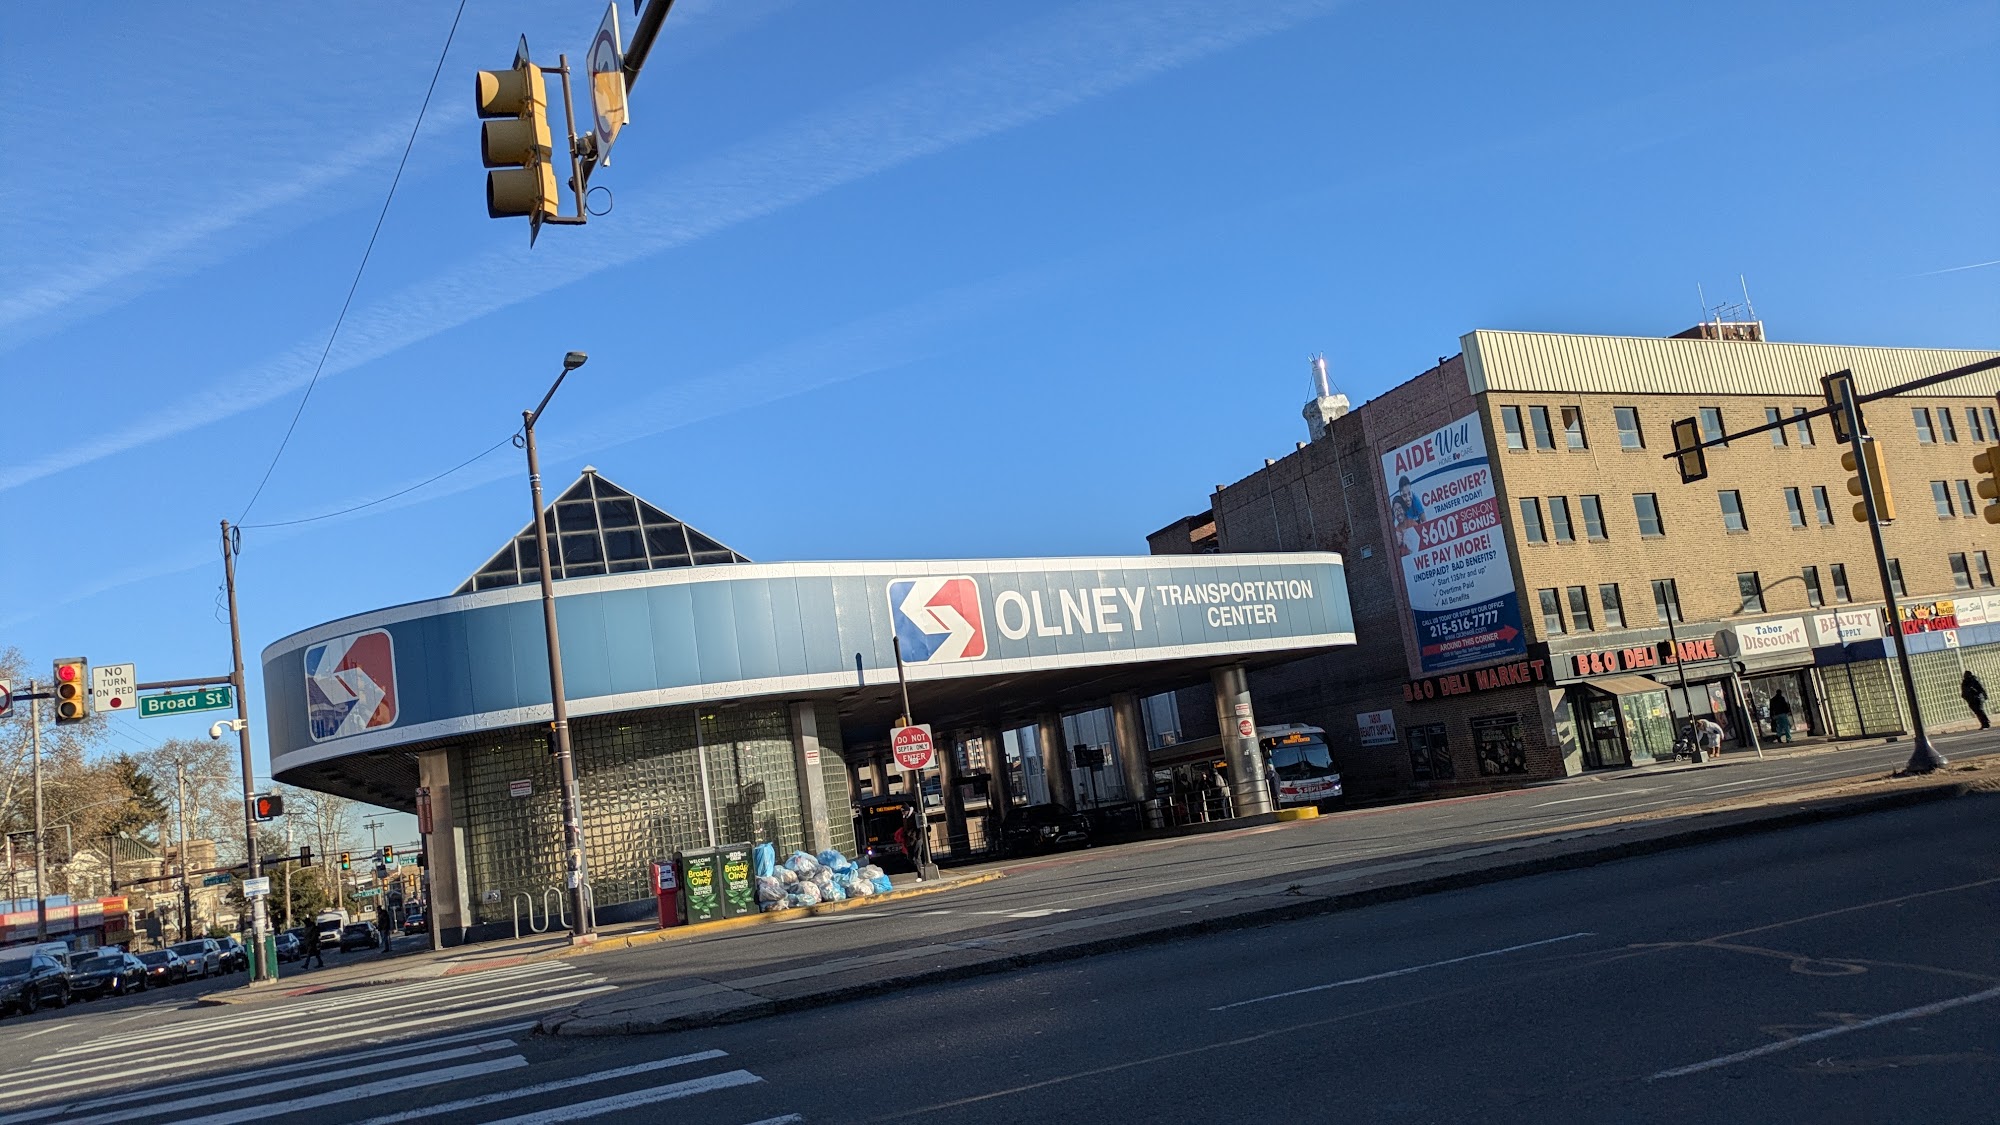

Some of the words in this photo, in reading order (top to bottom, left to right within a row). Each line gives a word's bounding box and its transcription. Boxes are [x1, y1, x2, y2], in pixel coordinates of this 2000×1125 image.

[1396, 438, 1435, 476] AIDE
[1435, 423, 1468, 456] Well
[1438, 456, 1452, 466] HOME
[1461, 446, 1473, 456] CARE
[1422, 469, 1486, 506] CAREGIVER?
[1434, 497, 1460, 514] TRANSFER
[1461, 489, 1483, 504] TODAY!
[1460, 502, 1493, 521] SIGN-ON
[1462, 512, 1496, 534] BONUS
[1414, 554, 1430, 570] WE
[1432, 546, 1451, 565] PAY
[1454, 534, 1491, 558] MORE!
[1414, 566, 1449, 582] UNDERPAID?
[1451, 561, 1465, 571] BAD
[1466, 550, 1496, 567] BENEFITS?
[1438, 577, 1449, 586] Start
[1467, 569, 1477, 578] and
[1439, 585, 1461, 596] Overtime
[1463, 581, 1474, 589] Paid
[1449, 593, 1469, 604] Benefits
[995, 586, 1146, 640] OLNEY
[1157, 580, 1314, 606] TRANSPORTATION
[1488, 601, 1504, 610] OFFICE
[1207, 604, 1278, 628] CENTER
[1430, 610, 1498, 638] 215-516-7777
[1820, 613, 1872, 634] BEAUTY
[1743, 628, 1800, 650] DISCOUNT
[1755, 625, 1783, 636] Tabor
[1837, 628, 1861, 638] SUPPLY
[1440, 640, 1462, 652] AROUND
[1462, 637, 1474, 647] THIS
[1475, 632, 1499, 644] CORNER
[1577, 651, 1616, 674] B&O
[1624, 646, 1658, 669] DELI
[104, 667, 122, 677] NO
[1403, 680, 1434, 701] B&O
[1440, 674, 1471, 696] DELI
[1476, 659, 1544, 690] MARKET
[96, 689, 109, 697] ON
[115, 686, 133, 695] RED
[102, 678, 127, 687] TURN
[148, 696, 196, 712] Broad
[206, 693, 222, 705] St
[692, 877, 711, 886] Olney
